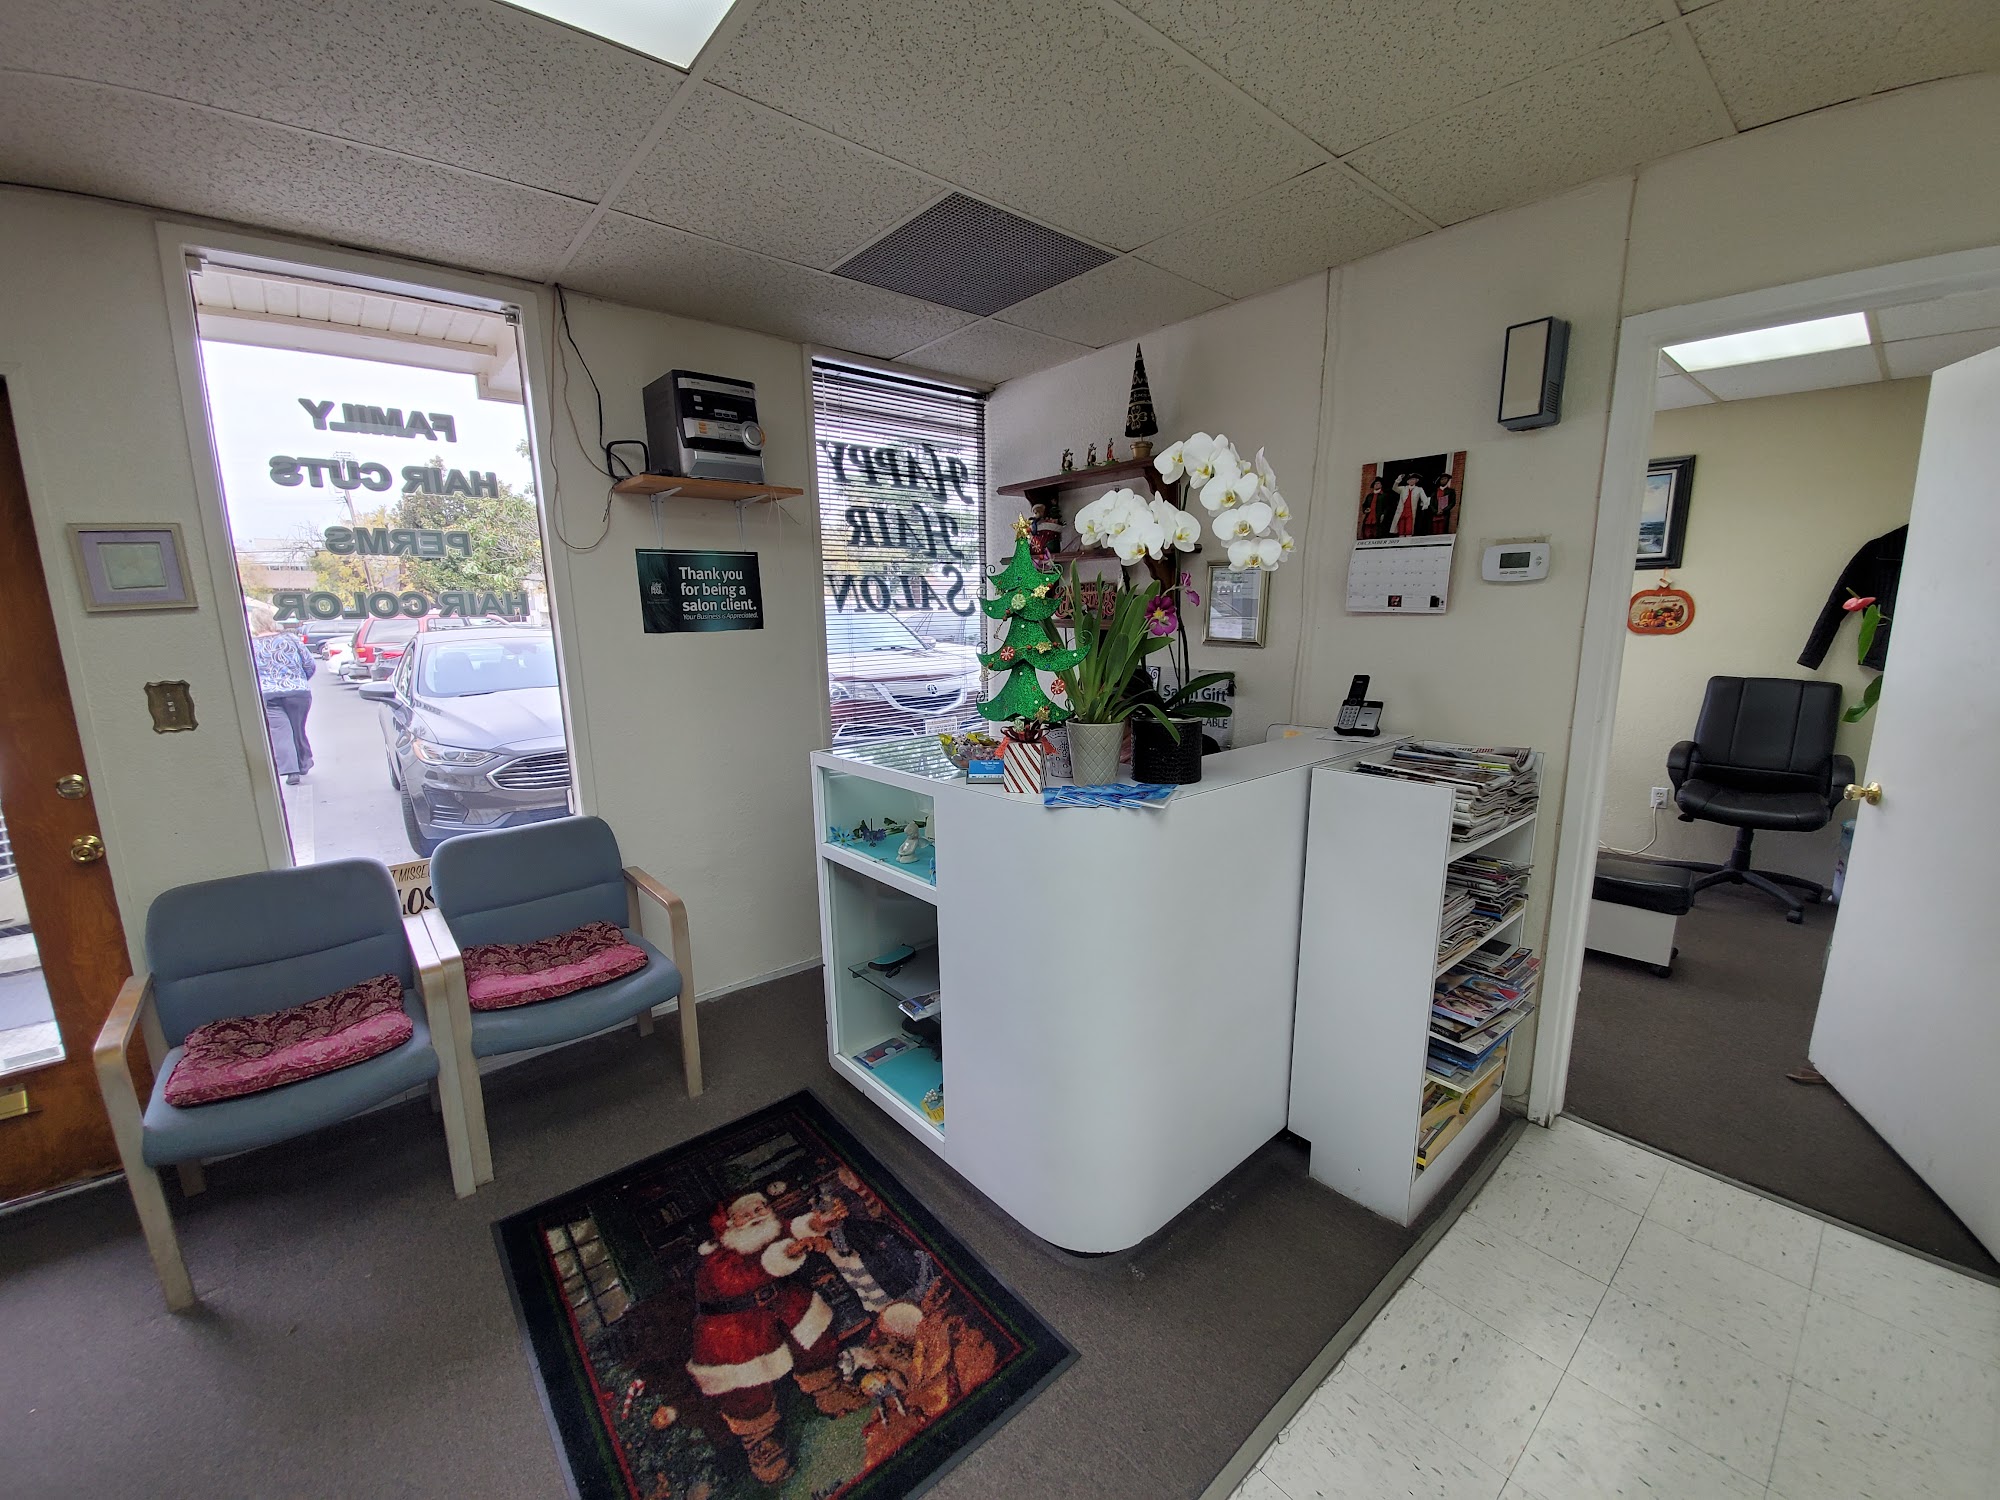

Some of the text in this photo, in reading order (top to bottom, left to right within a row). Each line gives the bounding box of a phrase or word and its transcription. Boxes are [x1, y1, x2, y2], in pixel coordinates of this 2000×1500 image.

[678, 566, 743, 583] Thank you
[680, 582, 700, 596] for
[702, 583, 737, 598] being
[739, 585, 747, 596] a
[683, 599, 718, 611] salon
[720, 598, 757, 611] client.
[1202, 687, 1227, 702] Gift
